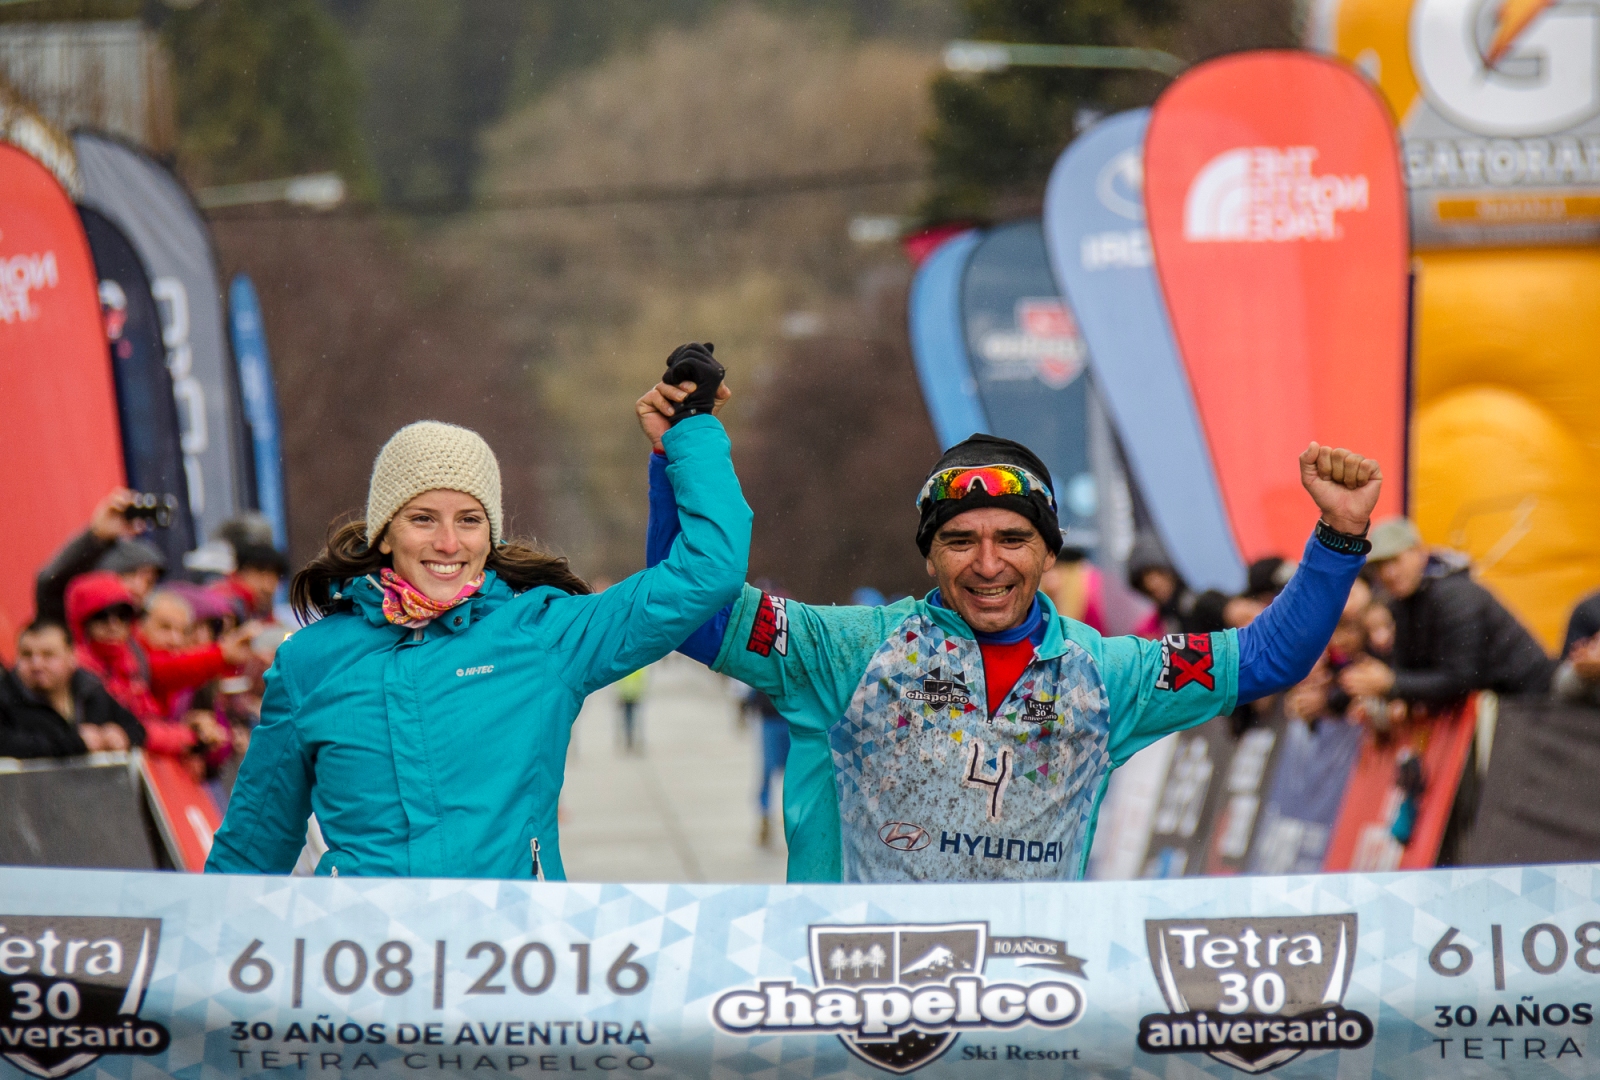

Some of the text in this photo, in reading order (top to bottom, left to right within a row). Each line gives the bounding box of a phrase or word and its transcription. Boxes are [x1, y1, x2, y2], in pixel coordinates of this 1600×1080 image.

[465, 665, 494, 676] HI-TEC
[906, 690, 968, 704] chapelco
[1035, 709, 1046, 717] 30
[966, 741, 1010, 819] 4
[940, 831, 1063, 863] HYUNDAI
[0, 925, 122, 977] etra
[994, 939, 1058, 955] 10 AÑOS
[1168, 928, 1322, 968] Tetra
[11, 982, 80, 1021] 30
[717, 981, 1078, 1034] chapelco
[1218, 972, 1286, 1014] 30
[1434, 996, 1594, 1028] 30 AÑOS
[0, 1021, 160, 1048] versario
[230, 1014, 651, 1046] 30 AÑOS DE AVENTURA
[1147, 1011, 1363, 1047] aniversario
[229, 1050, 654, 1072] TETRA CHAPELCO
[962, 1045, 1080, 1060] Ski Resort
[1432, 1037, 1583, 1060] TETRA
